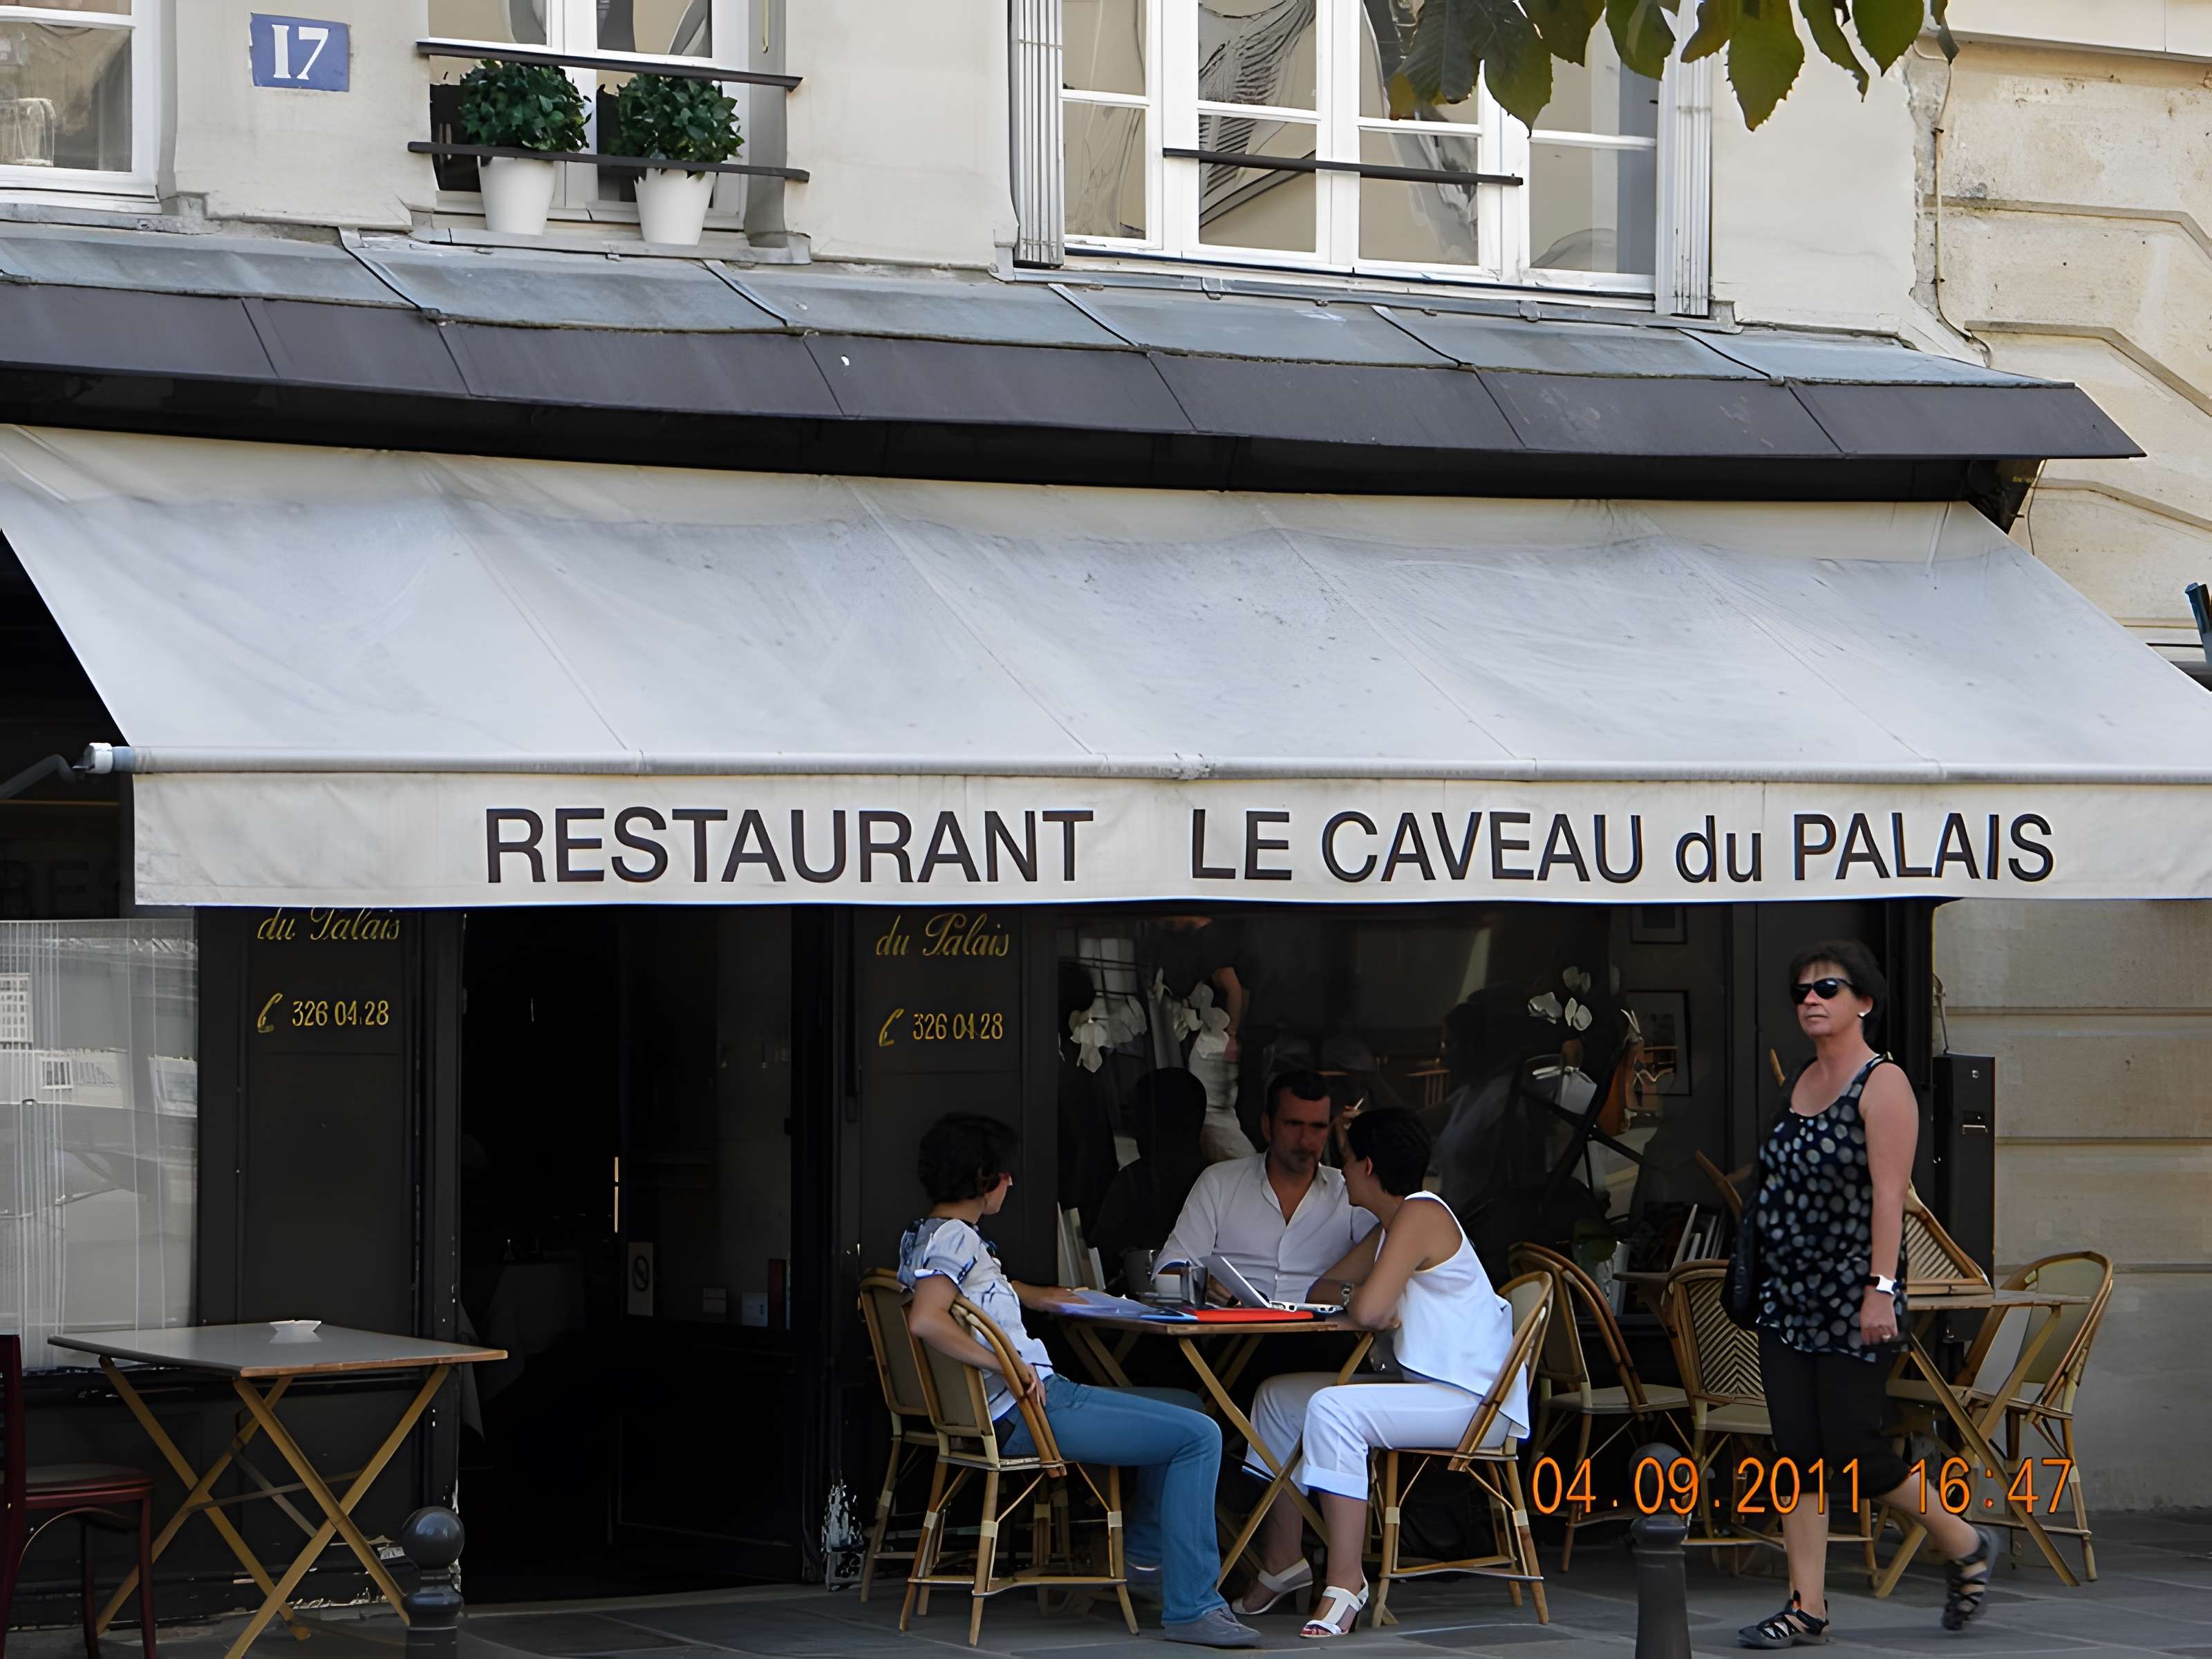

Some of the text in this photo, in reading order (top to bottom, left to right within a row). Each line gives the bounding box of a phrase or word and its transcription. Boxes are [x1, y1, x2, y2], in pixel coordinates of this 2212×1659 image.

[272, 24, 329, 80] 17
[485, 806, 2054, 884] RESTAURANT LE CAVEAU du PALAIS
[257, 908, 295, 940] du
[876, 912, 1009, 957] du Palais
[292, 1001, 328, 1027] 326
[912, 1013, 948, 1040] 326
